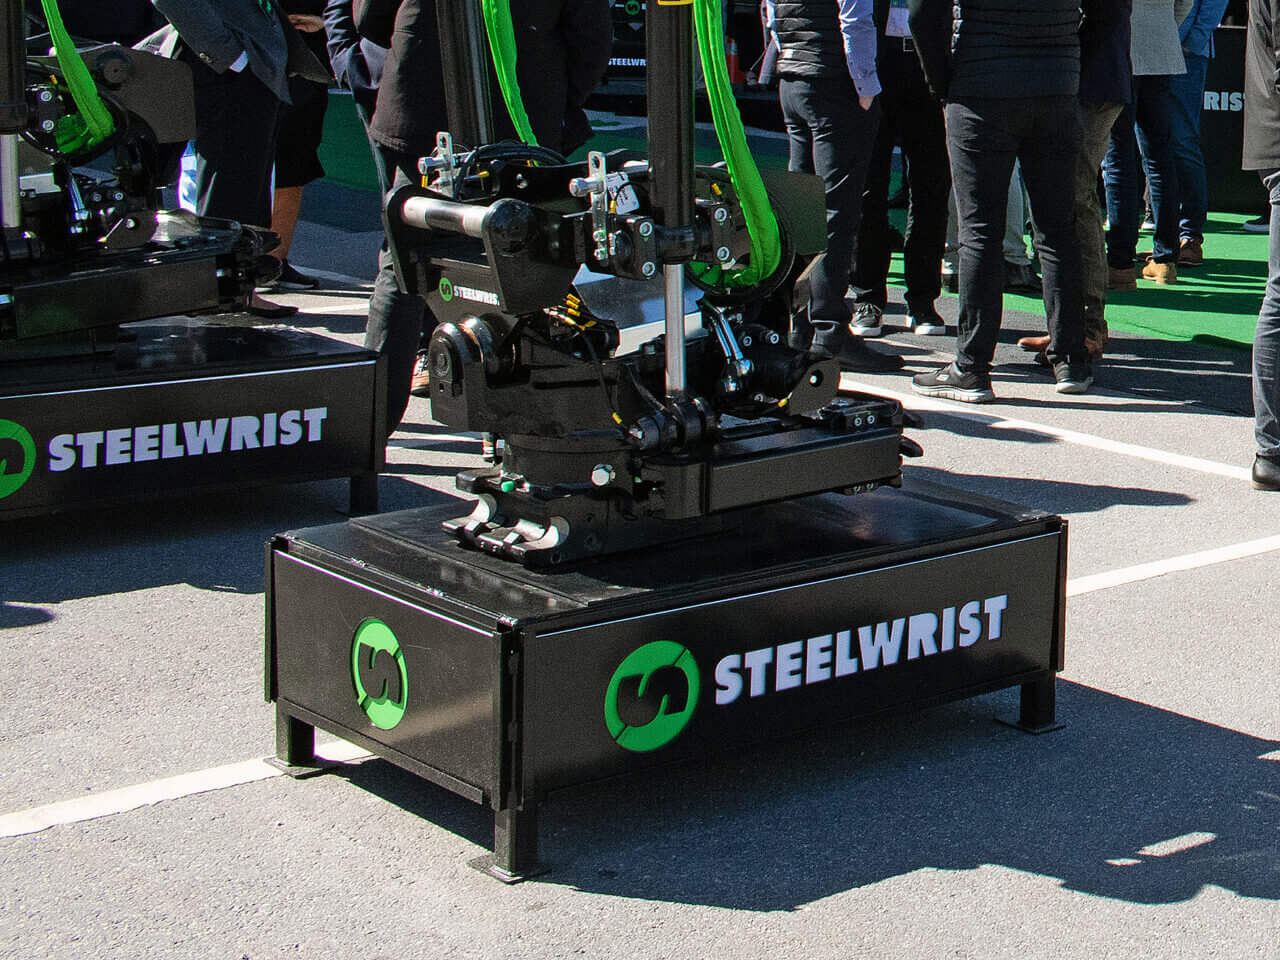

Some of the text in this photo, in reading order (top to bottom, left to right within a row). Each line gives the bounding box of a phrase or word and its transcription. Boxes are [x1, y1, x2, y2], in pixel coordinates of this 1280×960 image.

[1203, 91, 1245, 111] RIS
[48, 407, 327, 472] STEELWRIST
[714, 594, 1008, 705] STEELWRIST
